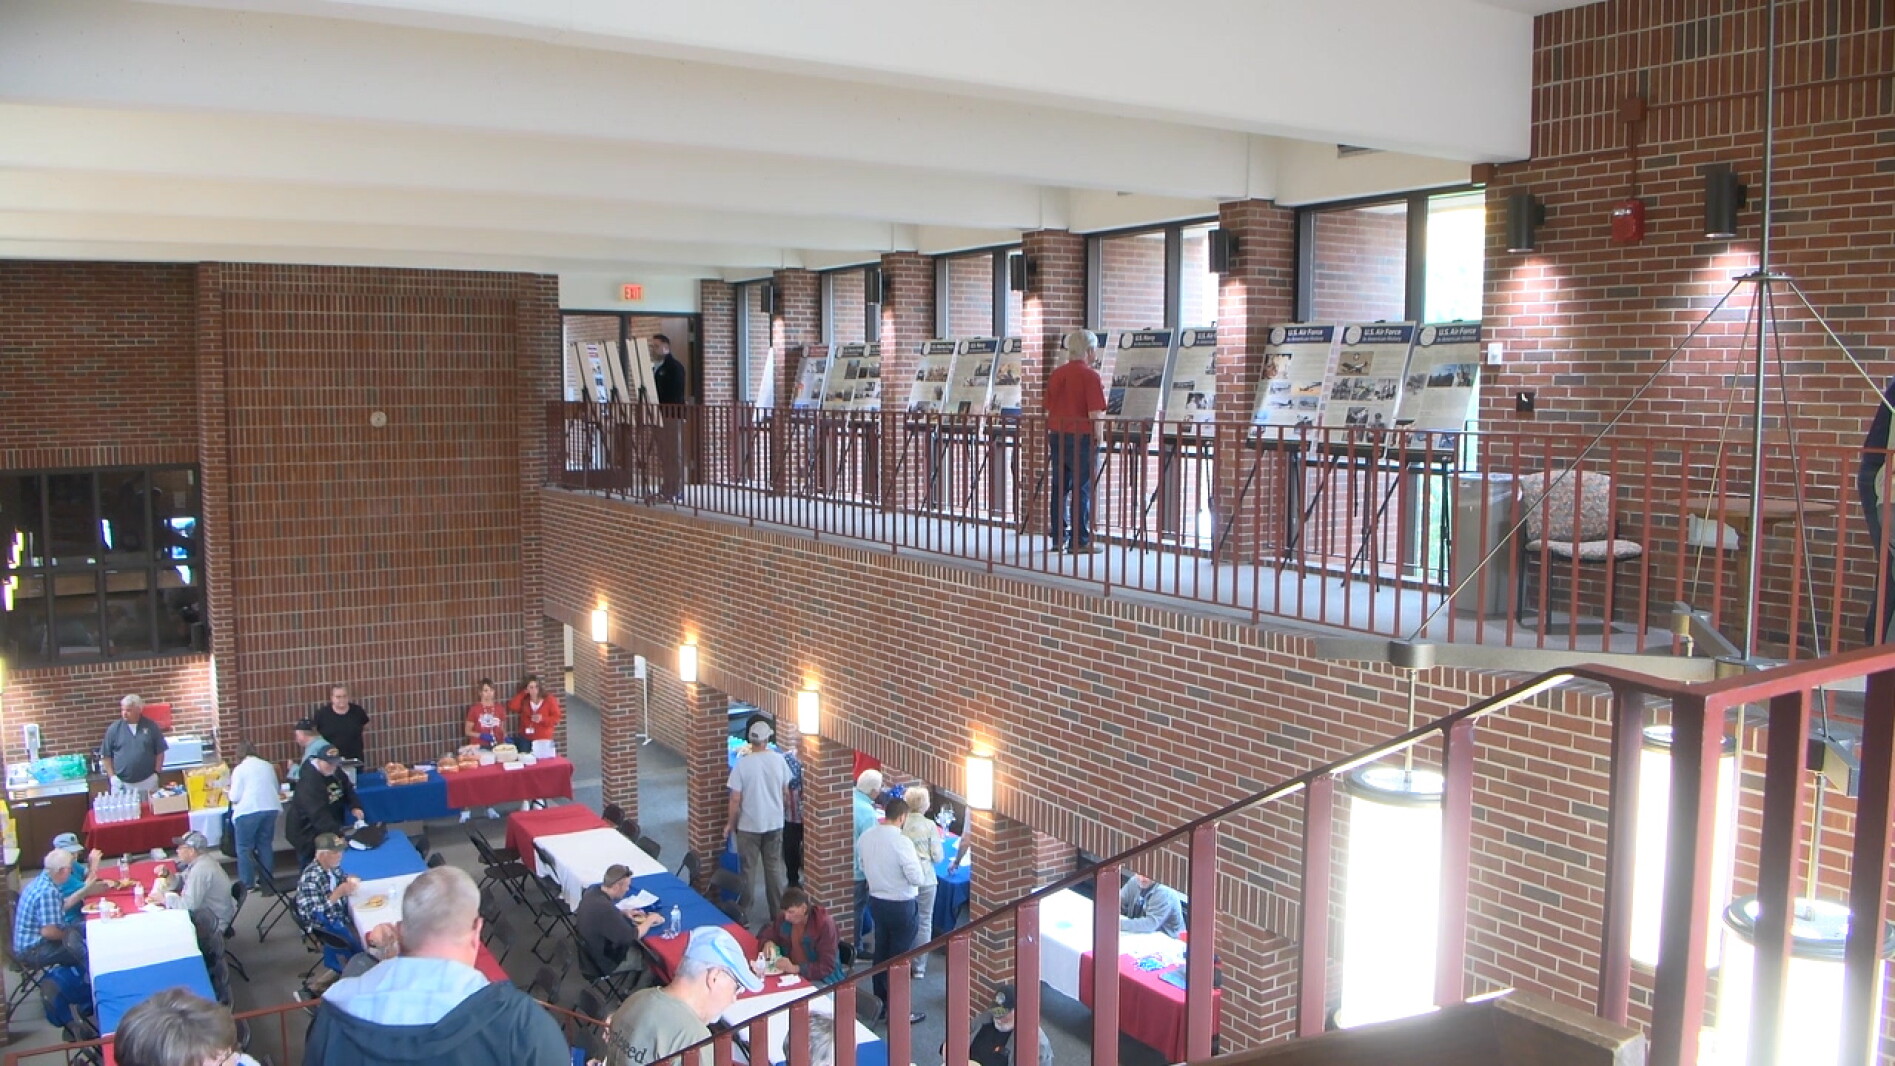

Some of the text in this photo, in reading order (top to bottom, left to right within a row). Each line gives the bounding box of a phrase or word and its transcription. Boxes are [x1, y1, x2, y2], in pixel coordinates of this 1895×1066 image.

[625, 287, 641, 300] EXIT
[1364, 328, 1374, 336] U.S.
[1450, 327, 1459, 335] Air
[1459, 327, 1477, 335] Force
